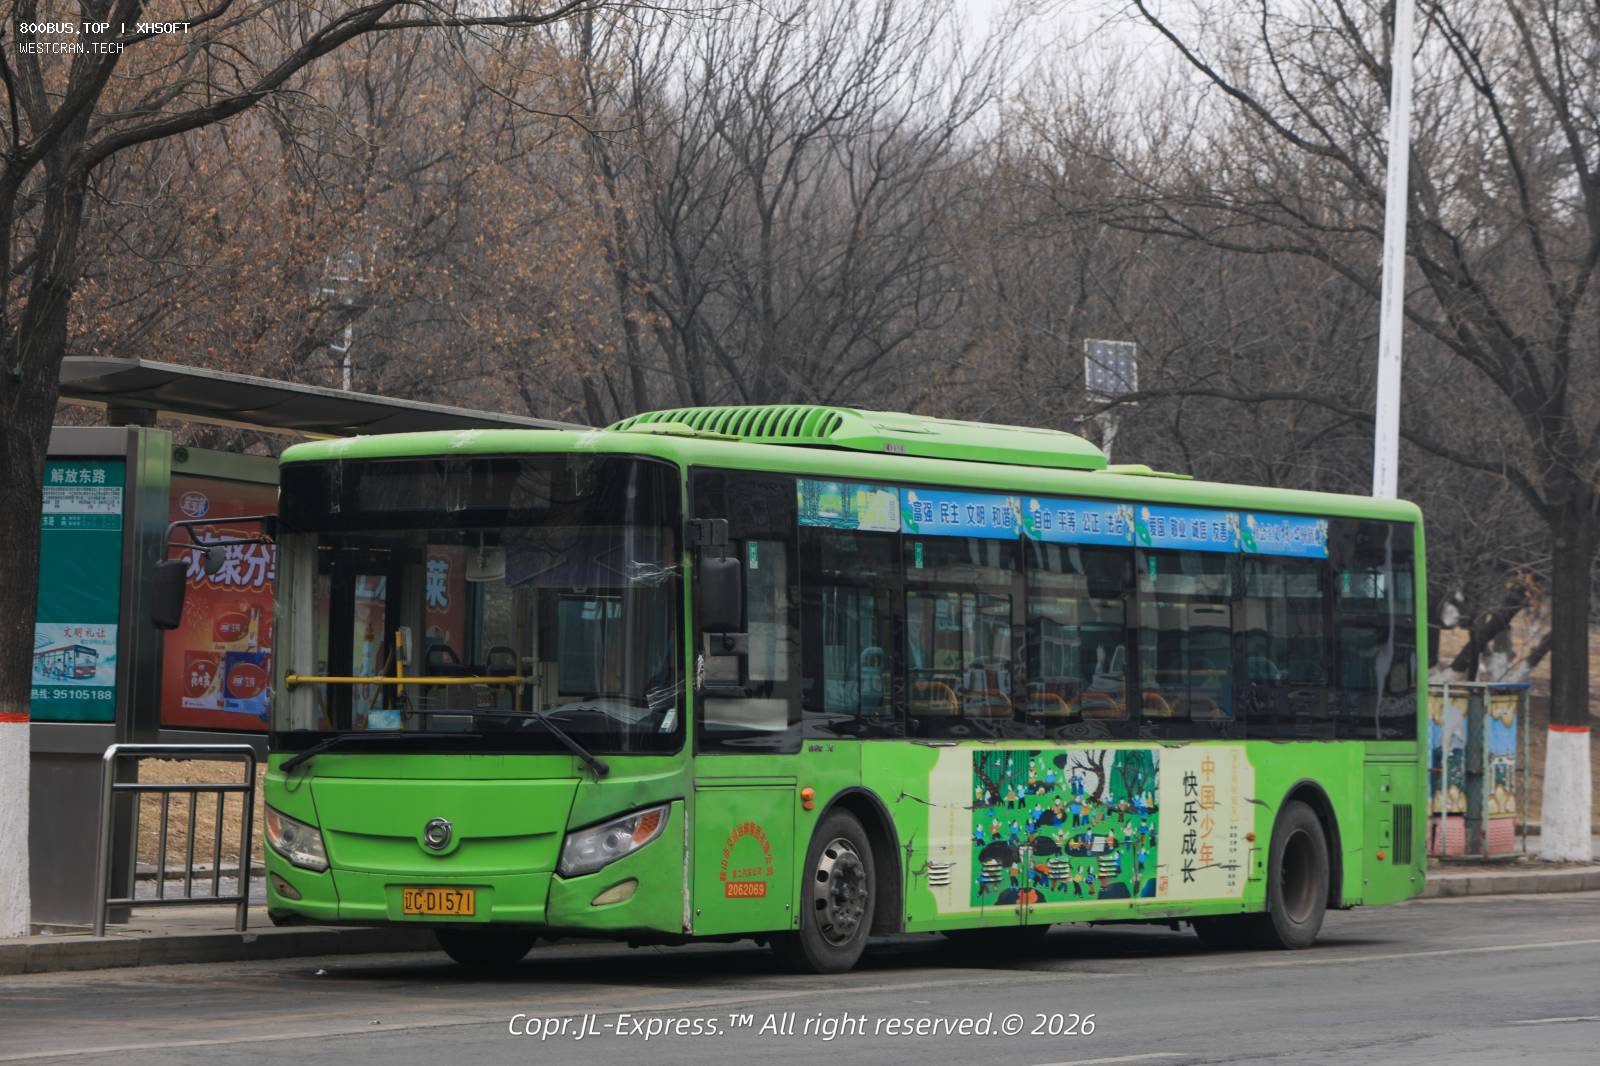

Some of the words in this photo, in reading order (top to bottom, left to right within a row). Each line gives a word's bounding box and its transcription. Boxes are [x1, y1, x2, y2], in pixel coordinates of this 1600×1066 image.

[51, 468, 106, 484] 解放东路
[912, 500, 934, 523] 富强
[940, 502, 960, 526] 民主
[966, 503, 985, 527] 文明
[1033, 508, 1052, 530] 自由
[1058, 510, 1077, 532] 平等
[1082, 511, 1100, 534] 公正
[1199, 756, 1215, 866] 中国少年
[1181, 770, 1198, 884] 快乐成长
